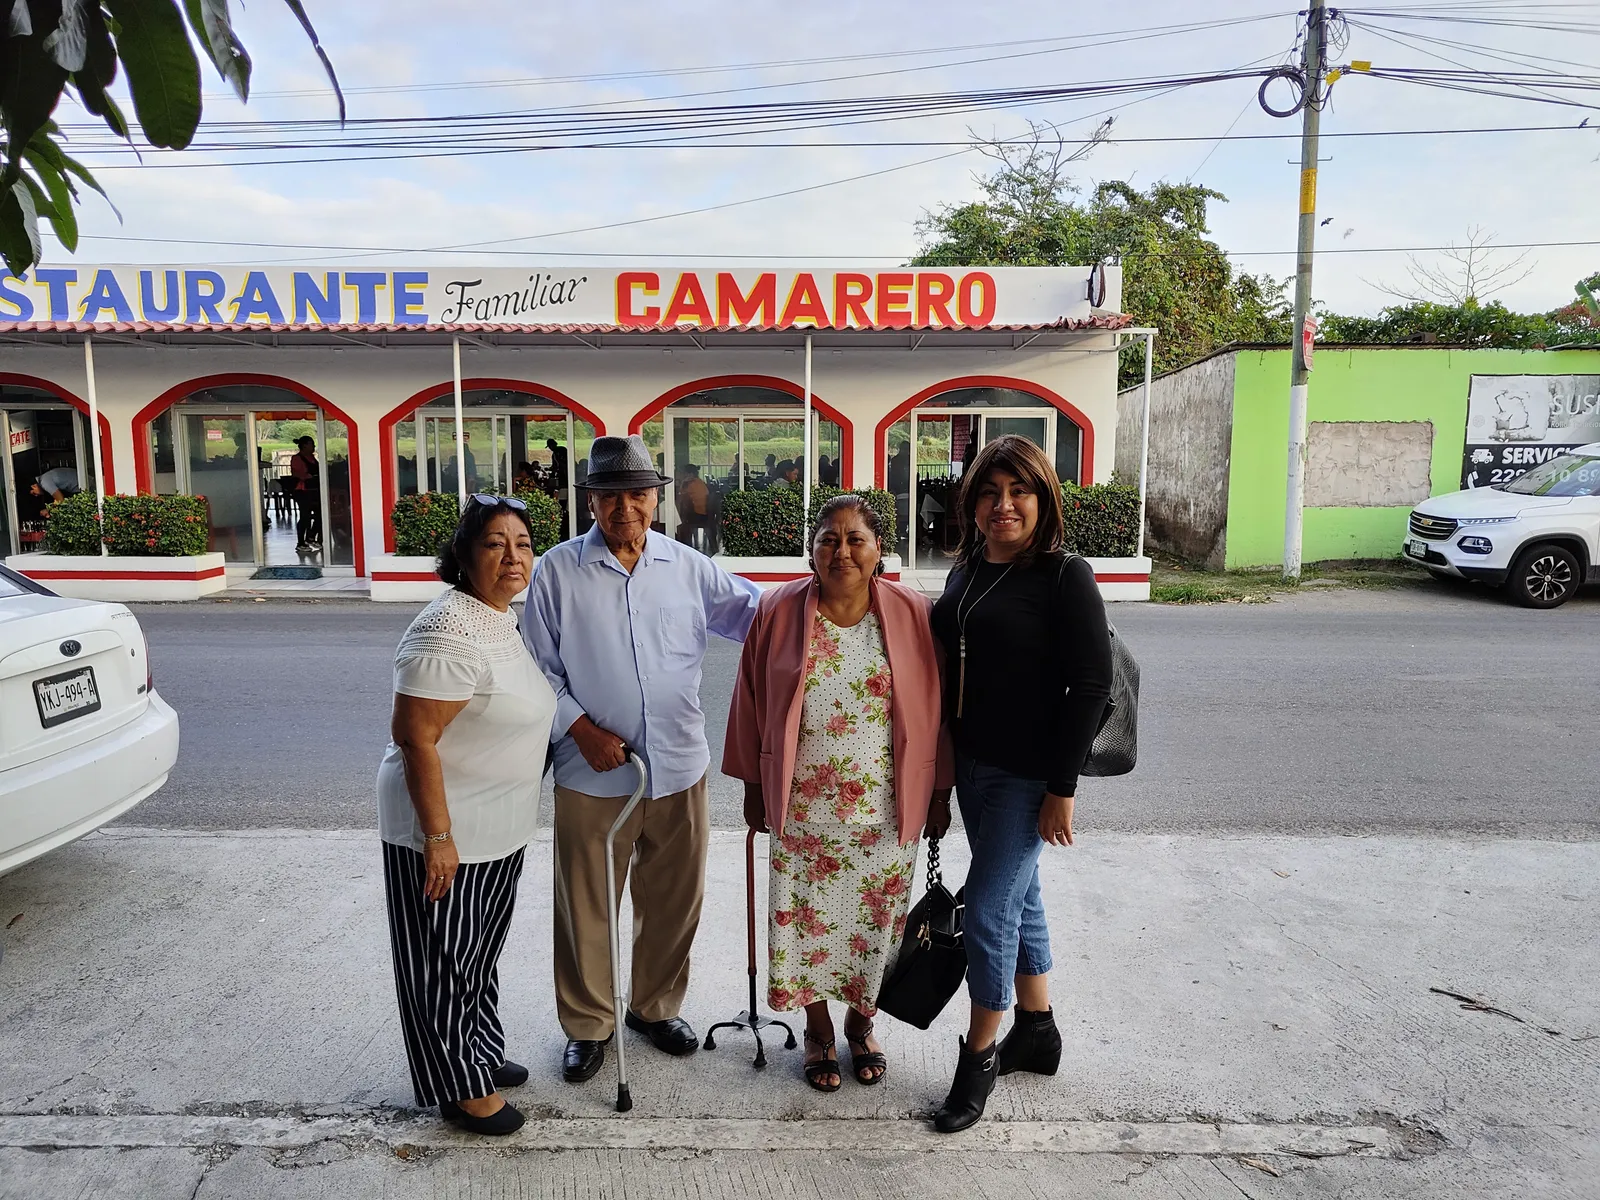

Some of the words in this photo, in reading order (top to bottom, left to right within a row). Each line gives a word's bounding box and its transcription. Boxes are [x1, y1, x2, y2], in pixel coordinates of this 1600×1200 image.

[0, 268, 429, 325] STAURANTE
[441, 273, 588, 323] Familiar
[614, 271, 997, 327] CAMARERO
[40, 678, 96, 712] YKJ-494-A
